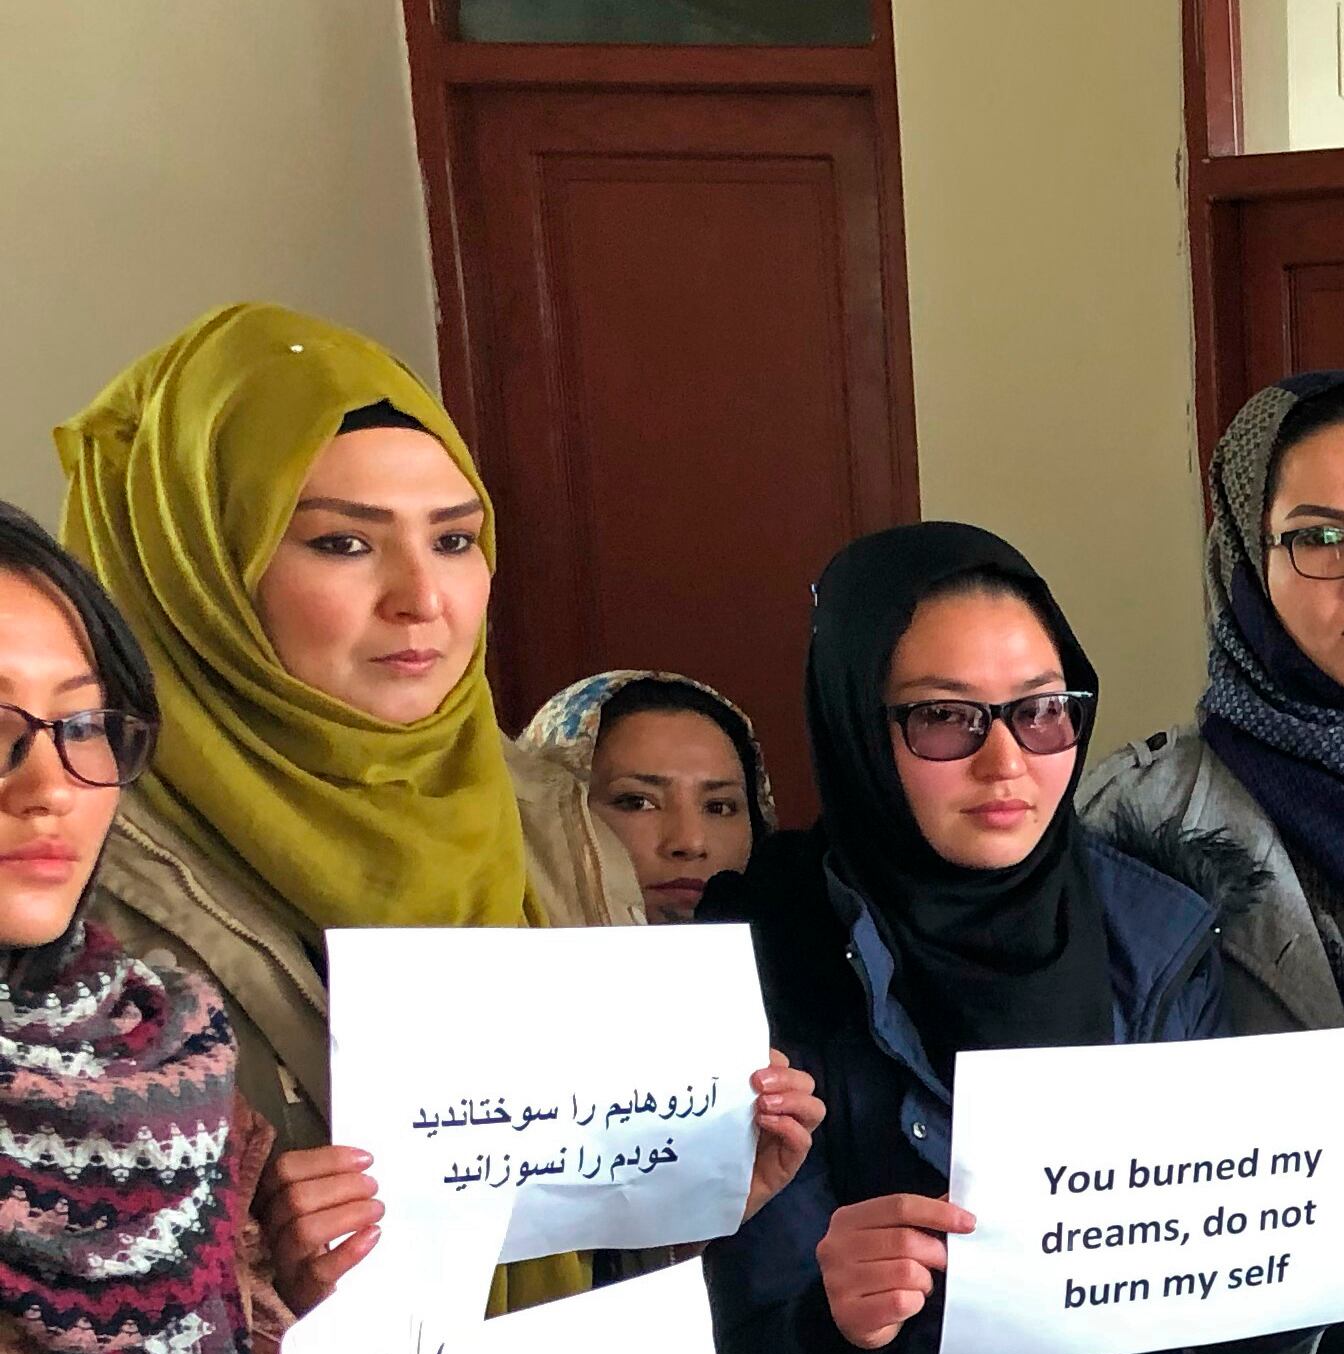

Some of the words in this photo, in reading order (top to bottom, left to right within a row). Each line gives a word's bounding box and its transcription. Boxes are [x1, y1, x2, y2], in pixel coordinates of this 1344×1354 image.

[412, 1097, 559, 1139] سوختاندید
[572, 1093, 596, 1127] را
[605, 1076, 719, 1130] آرزوهایم
[443, 1146, 568, 1192] نسوزانید
[577, 1145, 602, 1180] را
[610, 1137, 679, 1182] خودم
[1043, 1165, 1115, 1196] You
[1128, 1147, 1259, 1189] burned
[1270, 1148, 1323, 1178] my
[1041, 1218, 1190, 1255] dreams,
[1203, 1205, 1248, 1238] do
[1259, 1199, 1317, 1231] not
[1064, 1278, 1150, 1309] burn
[1163, 1270, 1219, 1300] my
[1227, 1253, 1291, 1290] self
